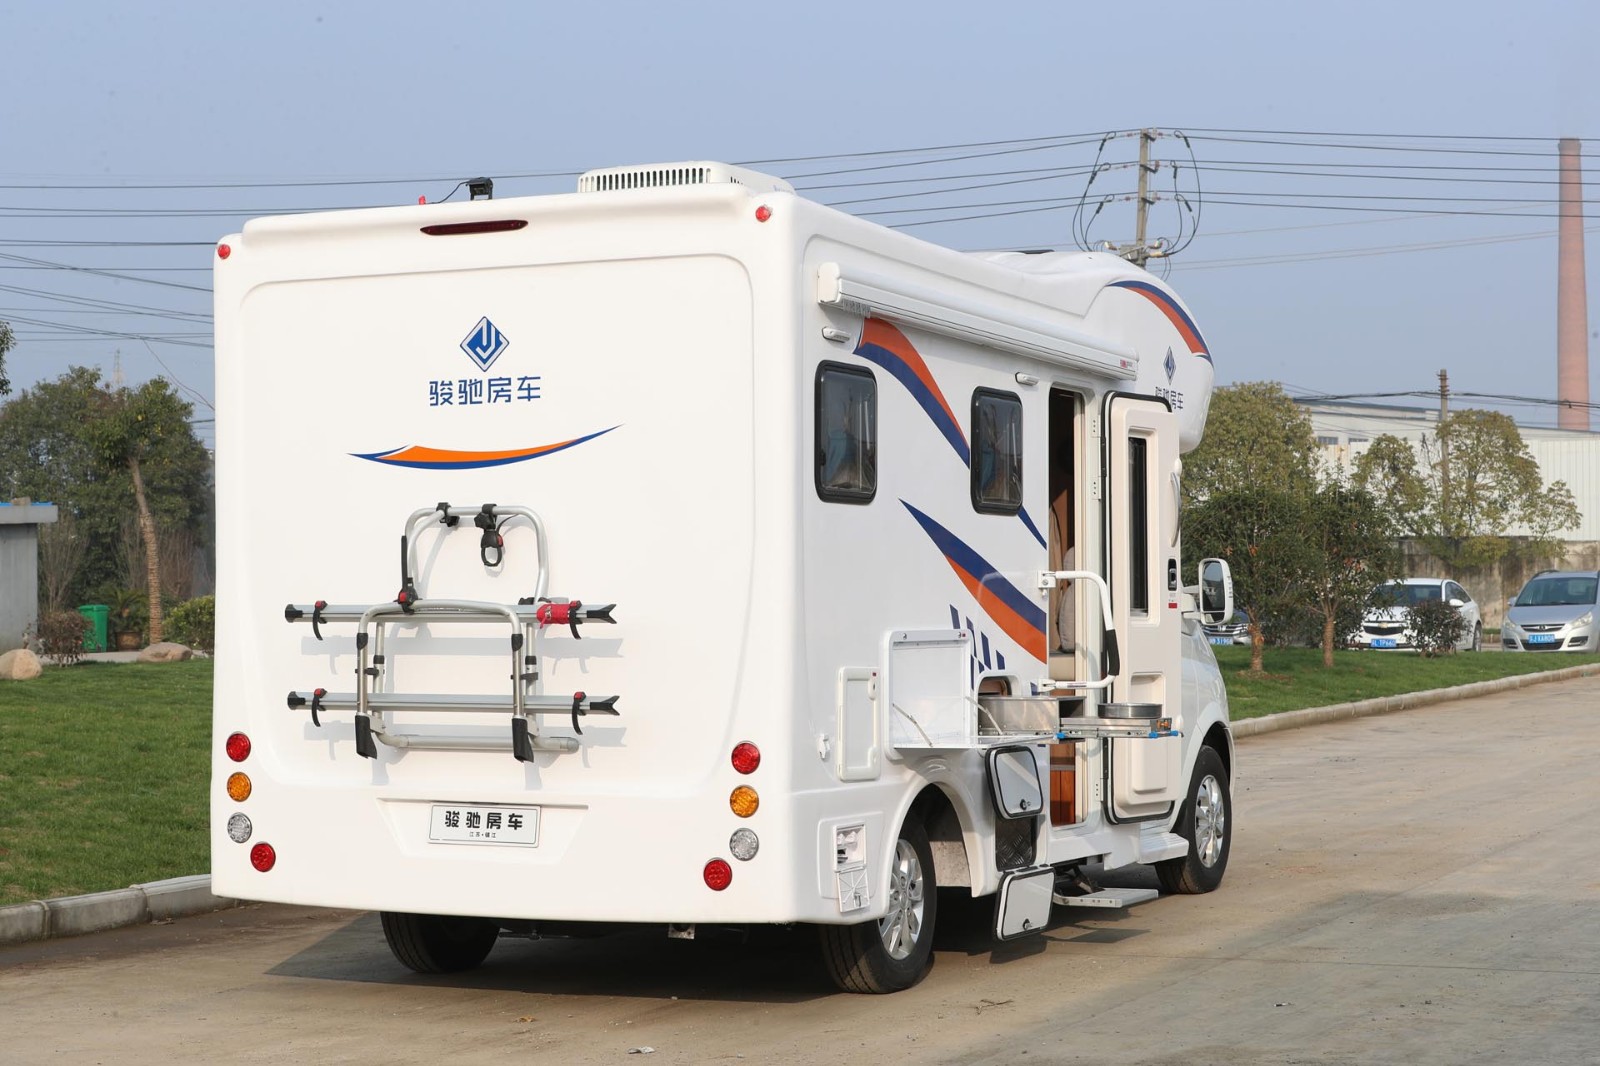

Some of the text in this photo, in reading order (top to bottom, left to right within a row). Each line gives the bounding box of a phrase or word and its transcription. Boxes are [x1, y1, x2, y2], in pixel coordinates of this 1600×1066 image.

[429, 375, 541, 407] 骏驰房车
[444, 810, 523, 830] 骏驰房车
